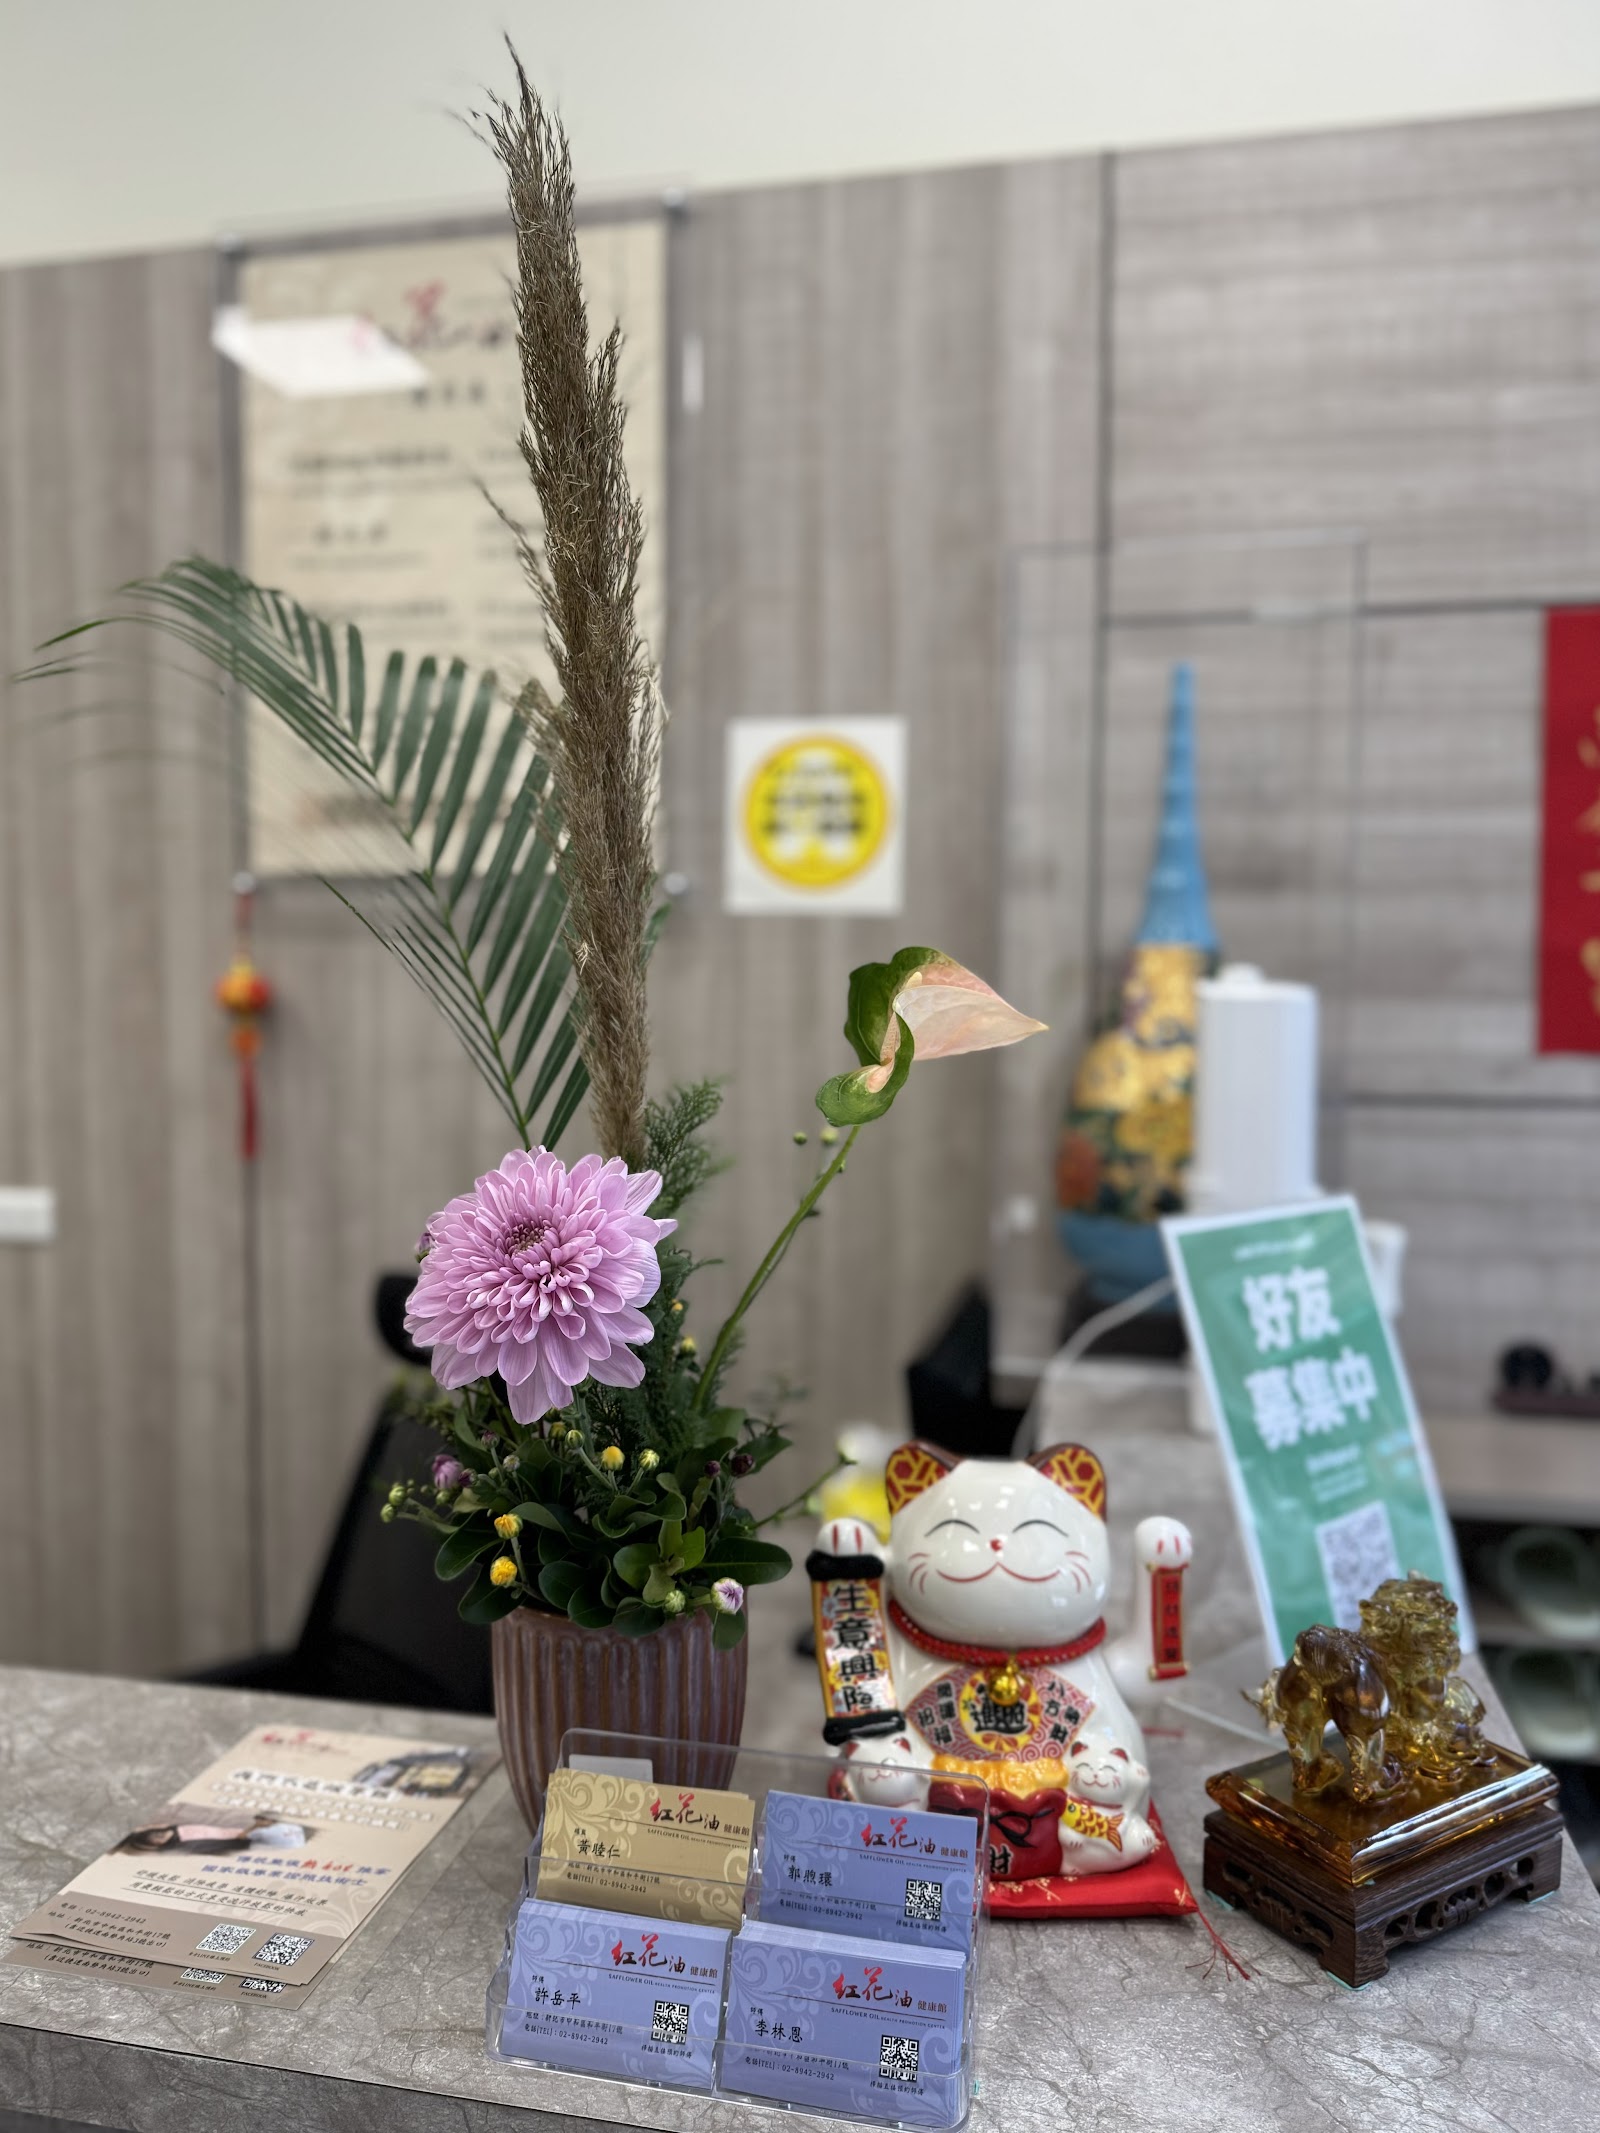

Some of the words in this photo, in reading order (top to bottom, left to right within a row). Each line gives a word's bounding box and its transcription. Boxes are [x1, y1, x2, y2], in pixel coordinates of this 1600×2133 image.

[1242, 1266, 1341, 1352] 好友
[1245, 1348, 1379, 1450] 募集中
[833, 1584, 880, 1712] 生意興隆
[647, 1828, 680, 1838] SAFFLOWER
[577, 1839, 620, 1859] 黃睦仁
[859, 1854, 894, 1864] SAFFLOWER
[254, 1962, 281, 1971] FACEBOOK
[608, 1973, 643, 1984] SAFFLOWER
[240, 1991, 267, 2000] FACEBOOK
[535, 1987, 581, 2010] 許岳平
[831, 2007, 868, 2018] SAFFLOWER
[755, 2019, 803, 2043] 李林恩
